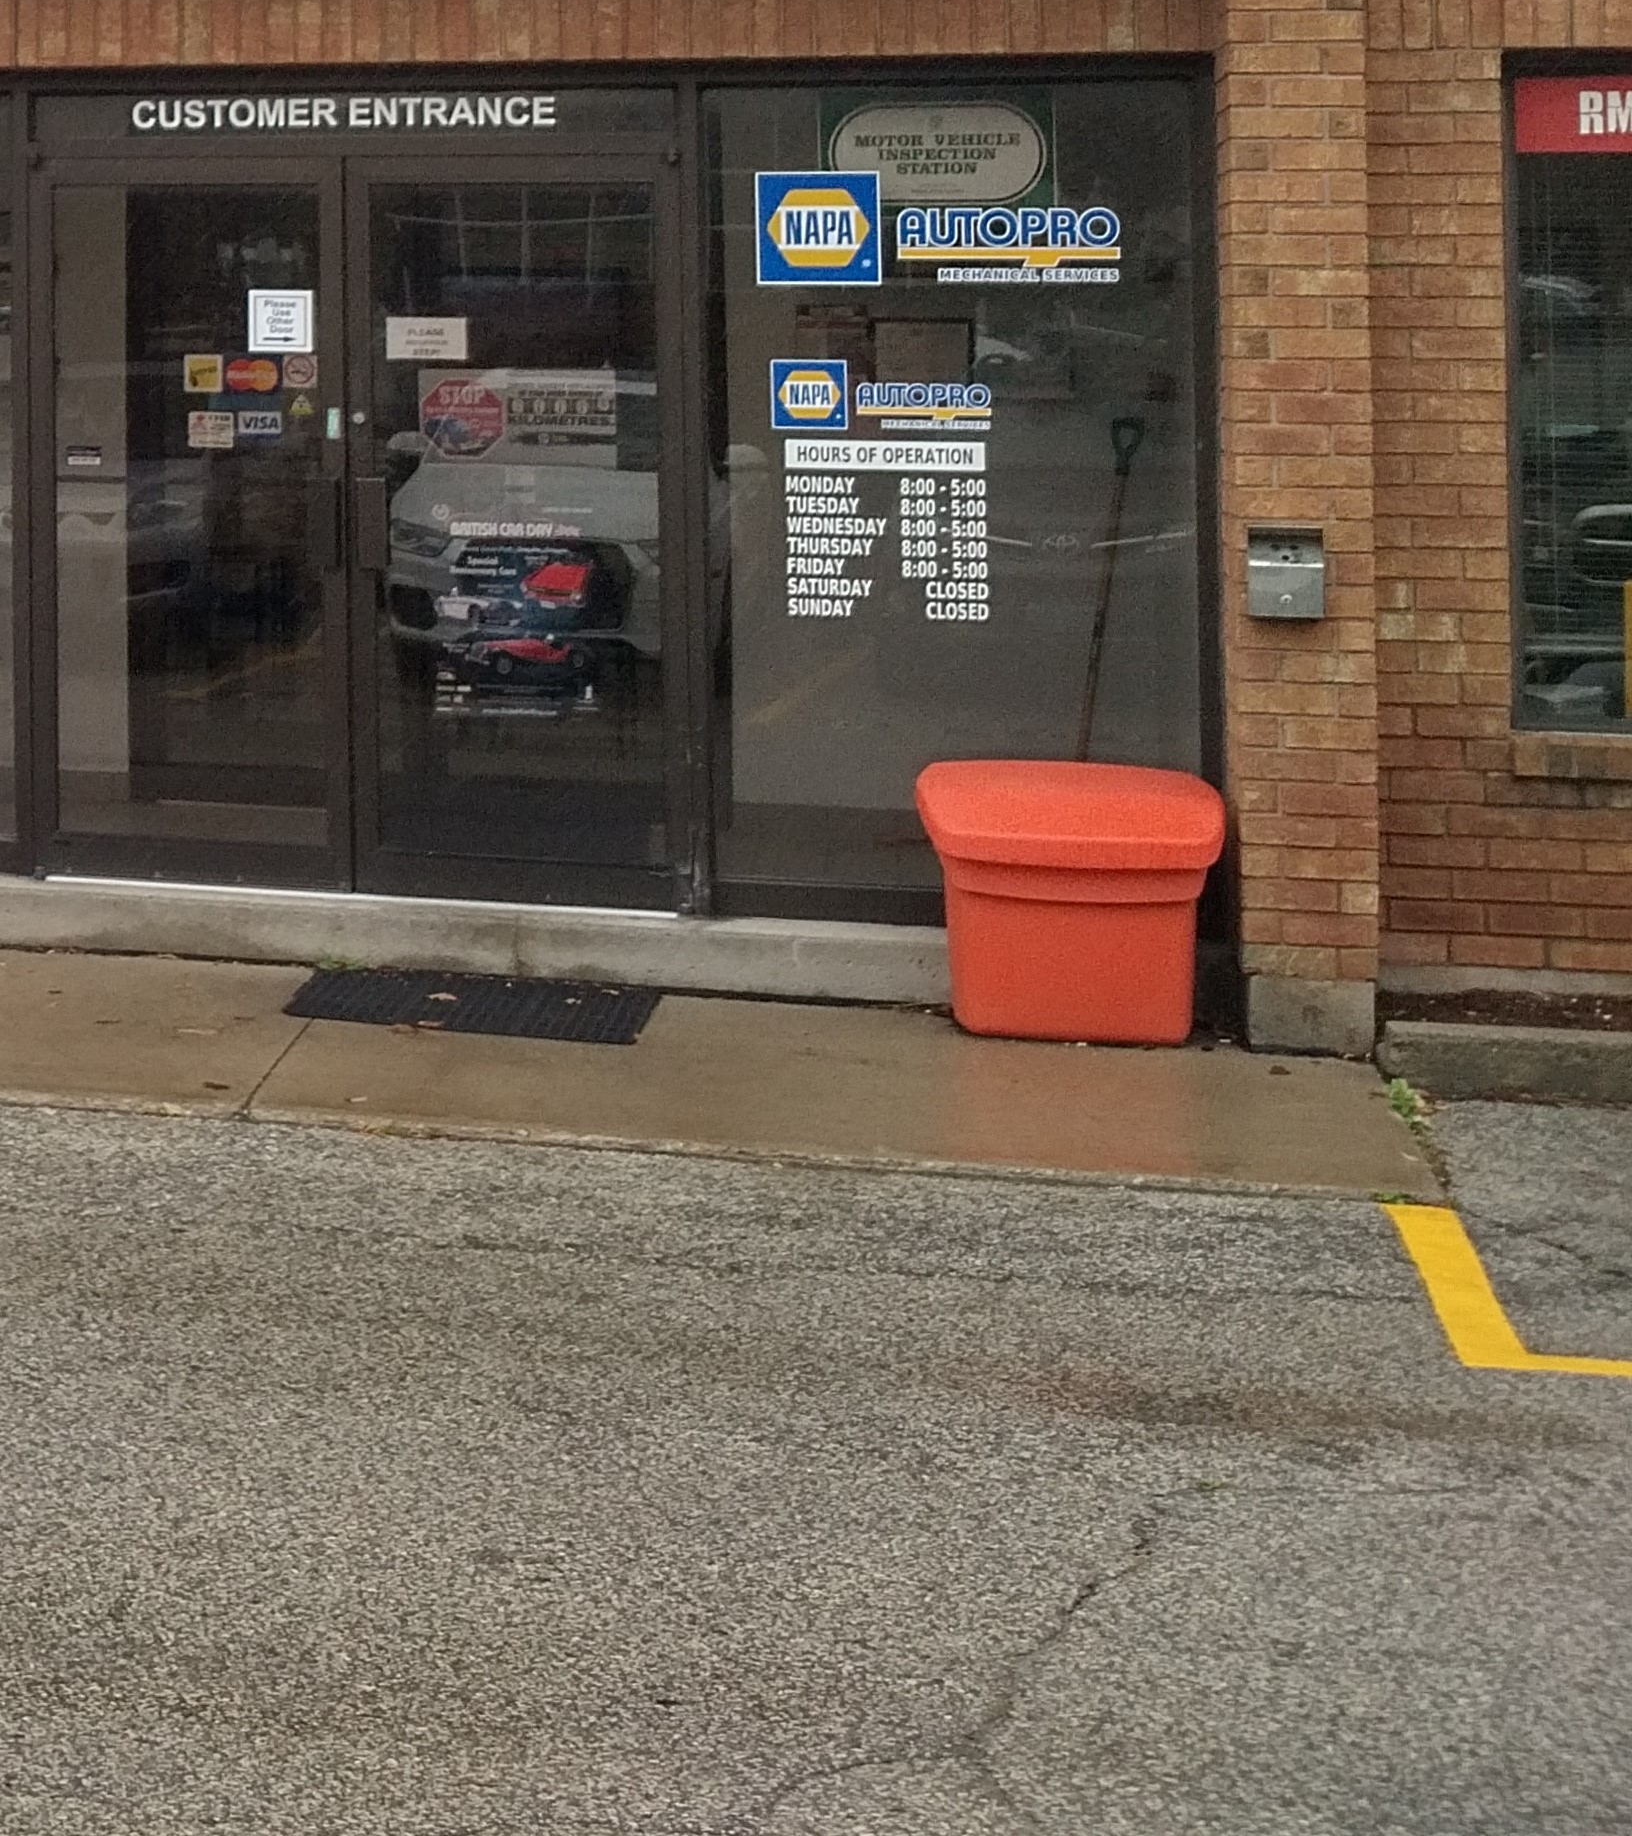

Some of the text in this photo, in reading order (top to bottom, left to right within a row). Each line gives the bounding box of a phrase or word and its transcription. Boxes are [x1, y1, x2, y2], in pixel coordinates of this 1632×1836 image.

[132, 95, 556, 129] CUSTOMER ENTRANCE
[854, 132, 1021, 148] MOTOR VEHICLE
[878, 147, 997, 161] INSPECTION
[896, 162, 977, 175] STATION
[786, 209, 854, 246] NAPA
[896, 207, 1121, 248] AUTOPRO
[937, 268, 1120, 282] MECHANICAL SERVICES
[264, 299, 297, 308] Please
[789, 383, 831, 406] NAPA
[856, 382, 991, 407] AUTOPRO
[242, 416, 278, 430] VISA
[797, 445, 974, 465] HOURS OF OPERATION
[786, 475, 855, 494] MONDAY
[900, 478, 935, 496] 8:00
[950, 479, 986, 497] 5:00
[786, 496, 860, 515] TUESDAY
[900, 498, 935, 516] 8:00
[951, 499, 986, 517] 5:00
[499, 522, 524, 536] CAR
[526, 522, 553, 537] DAY
[787, 517, 886, 536] WEDNESDAY
[901, 519, 936, 537] 8:00
[951, 520, 987, 538] 5:00
[787, 537, 873, 556] THURSDAY
[901, 539, 936, 557] 8:00
[952, 541, 987, 558] 5:00
[787, 557, 845, 576] FRIDAY
[902, 560, 937, 578] 8:00
[952, 561, 988, 579] 5:00
[787, 577, 989, 599] SATURDAY CLOSED
[788, 598, 989, 620] SUNDAY CLOSED
